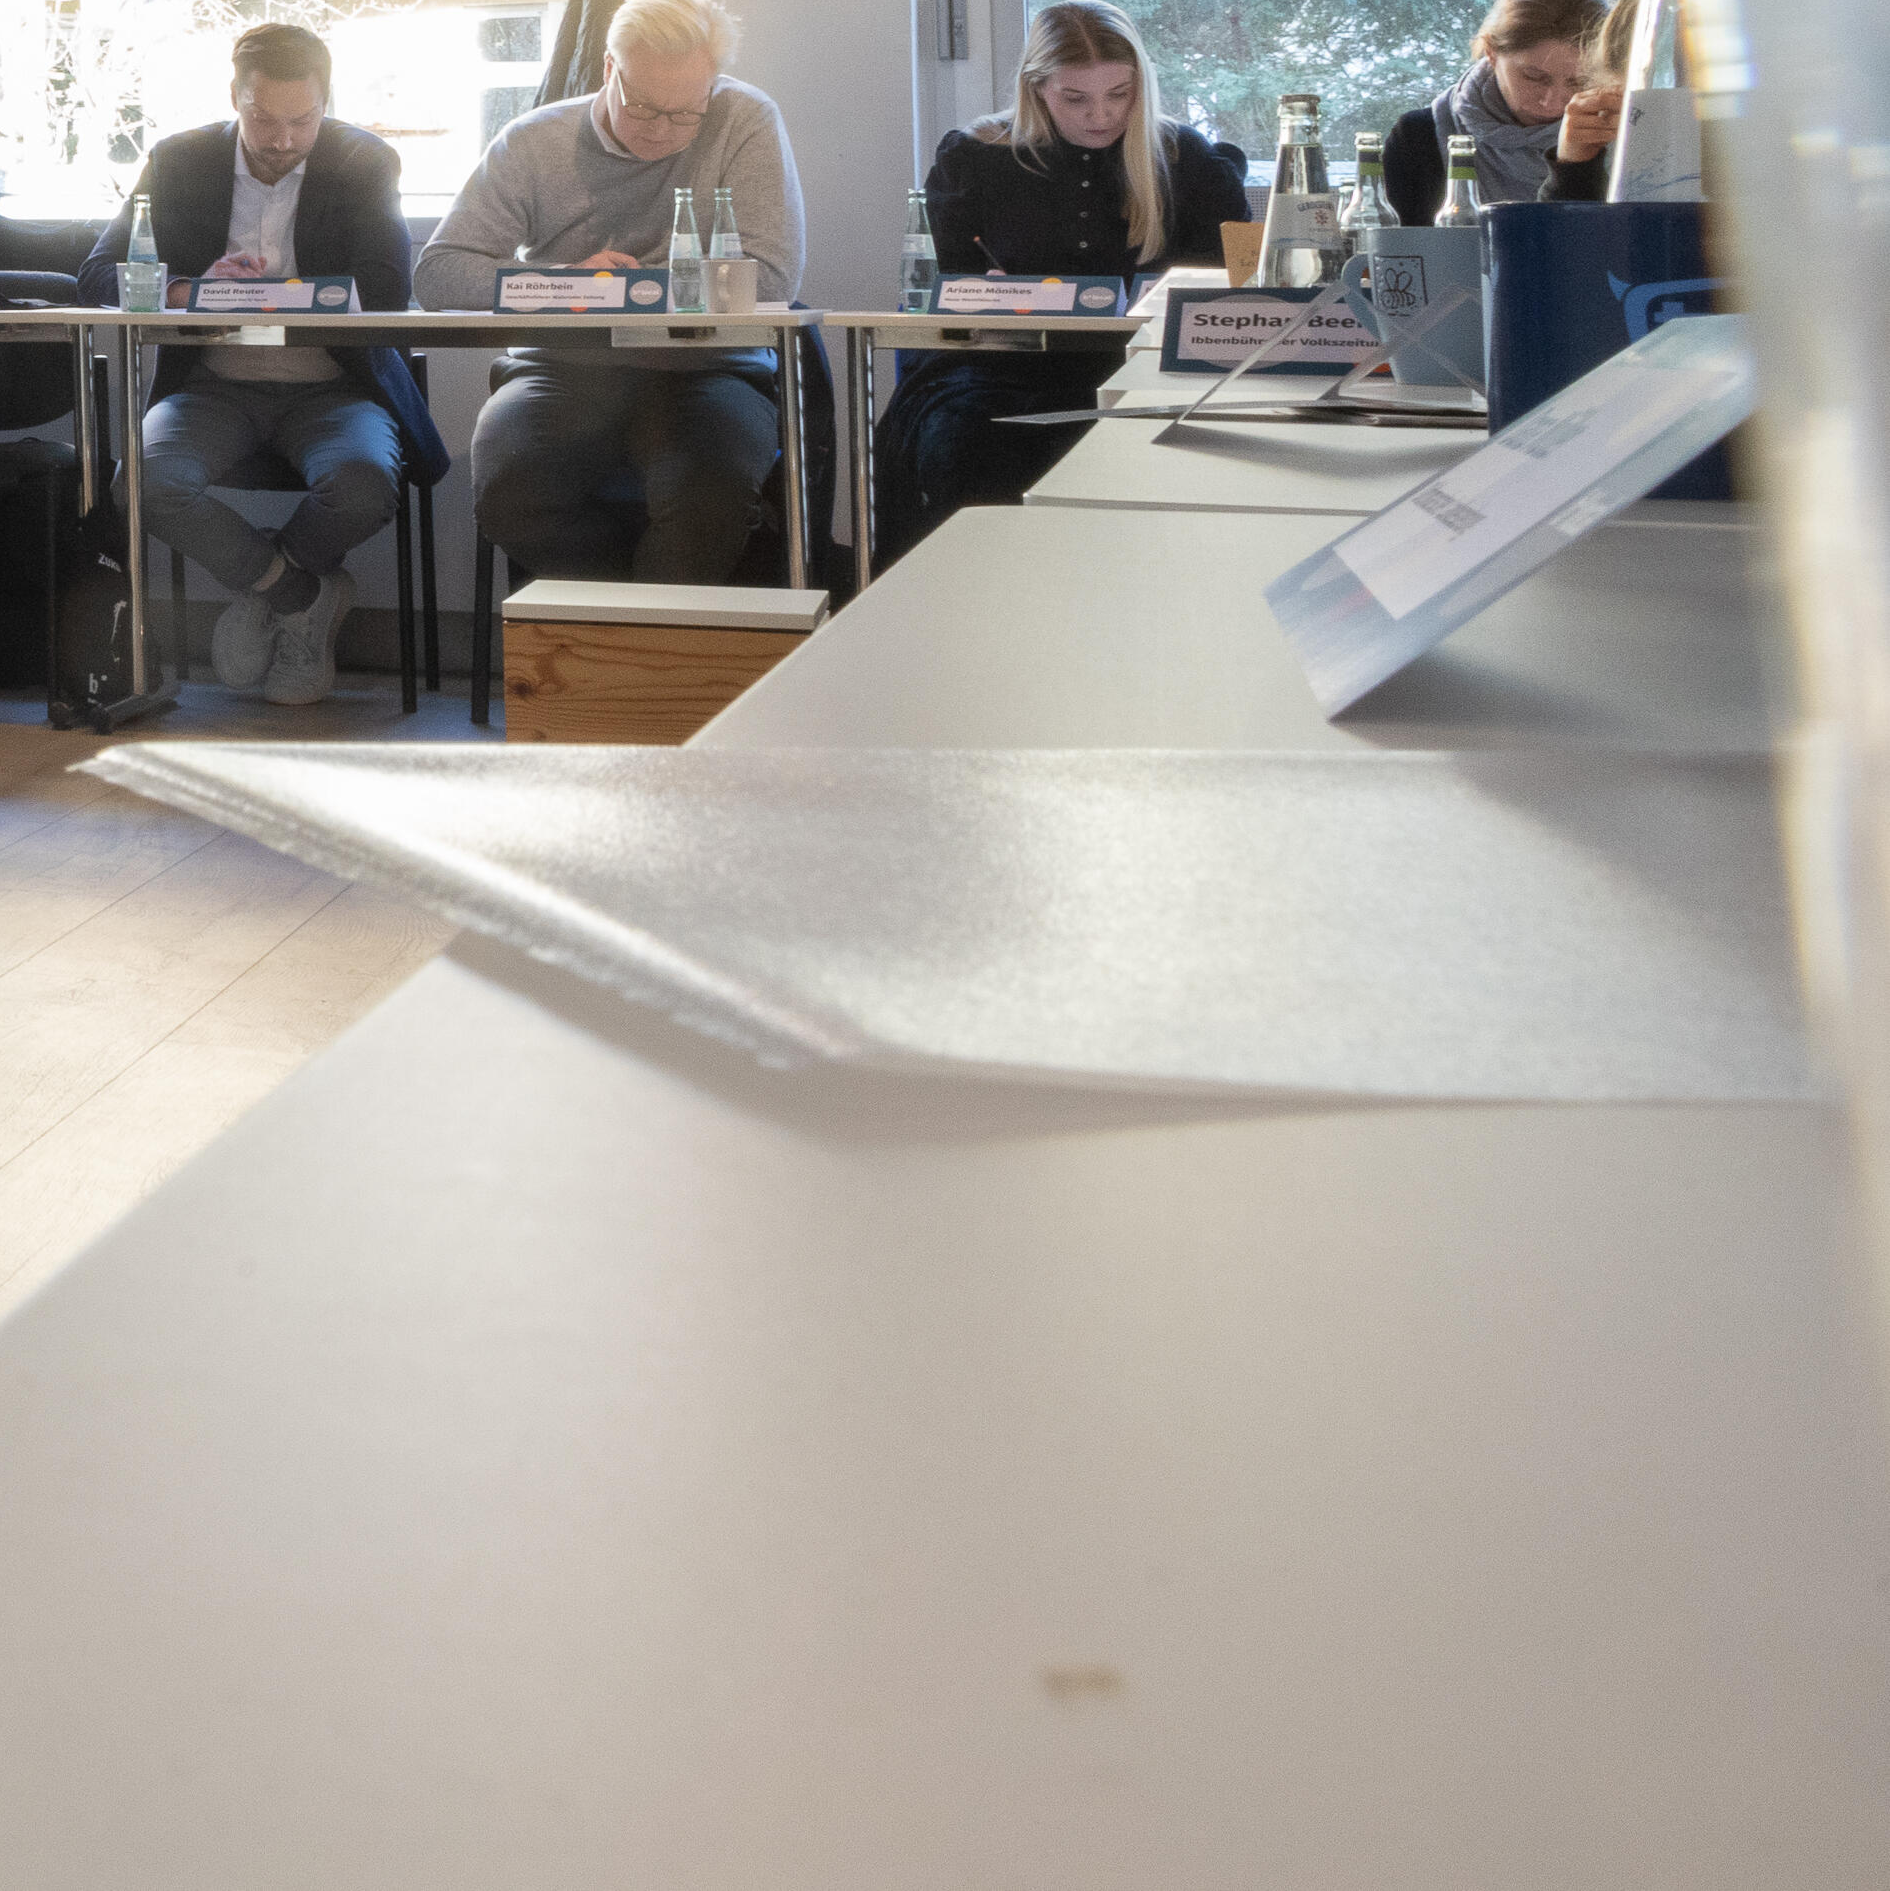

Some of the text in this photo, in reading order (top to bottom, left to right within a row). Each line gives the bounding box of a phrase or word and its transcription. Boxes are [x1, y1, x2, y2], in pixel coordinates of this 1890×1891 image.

[506, 282, 574, 290] Kai Röhrbein
[985, 286, 1032, 295] Mönikes
